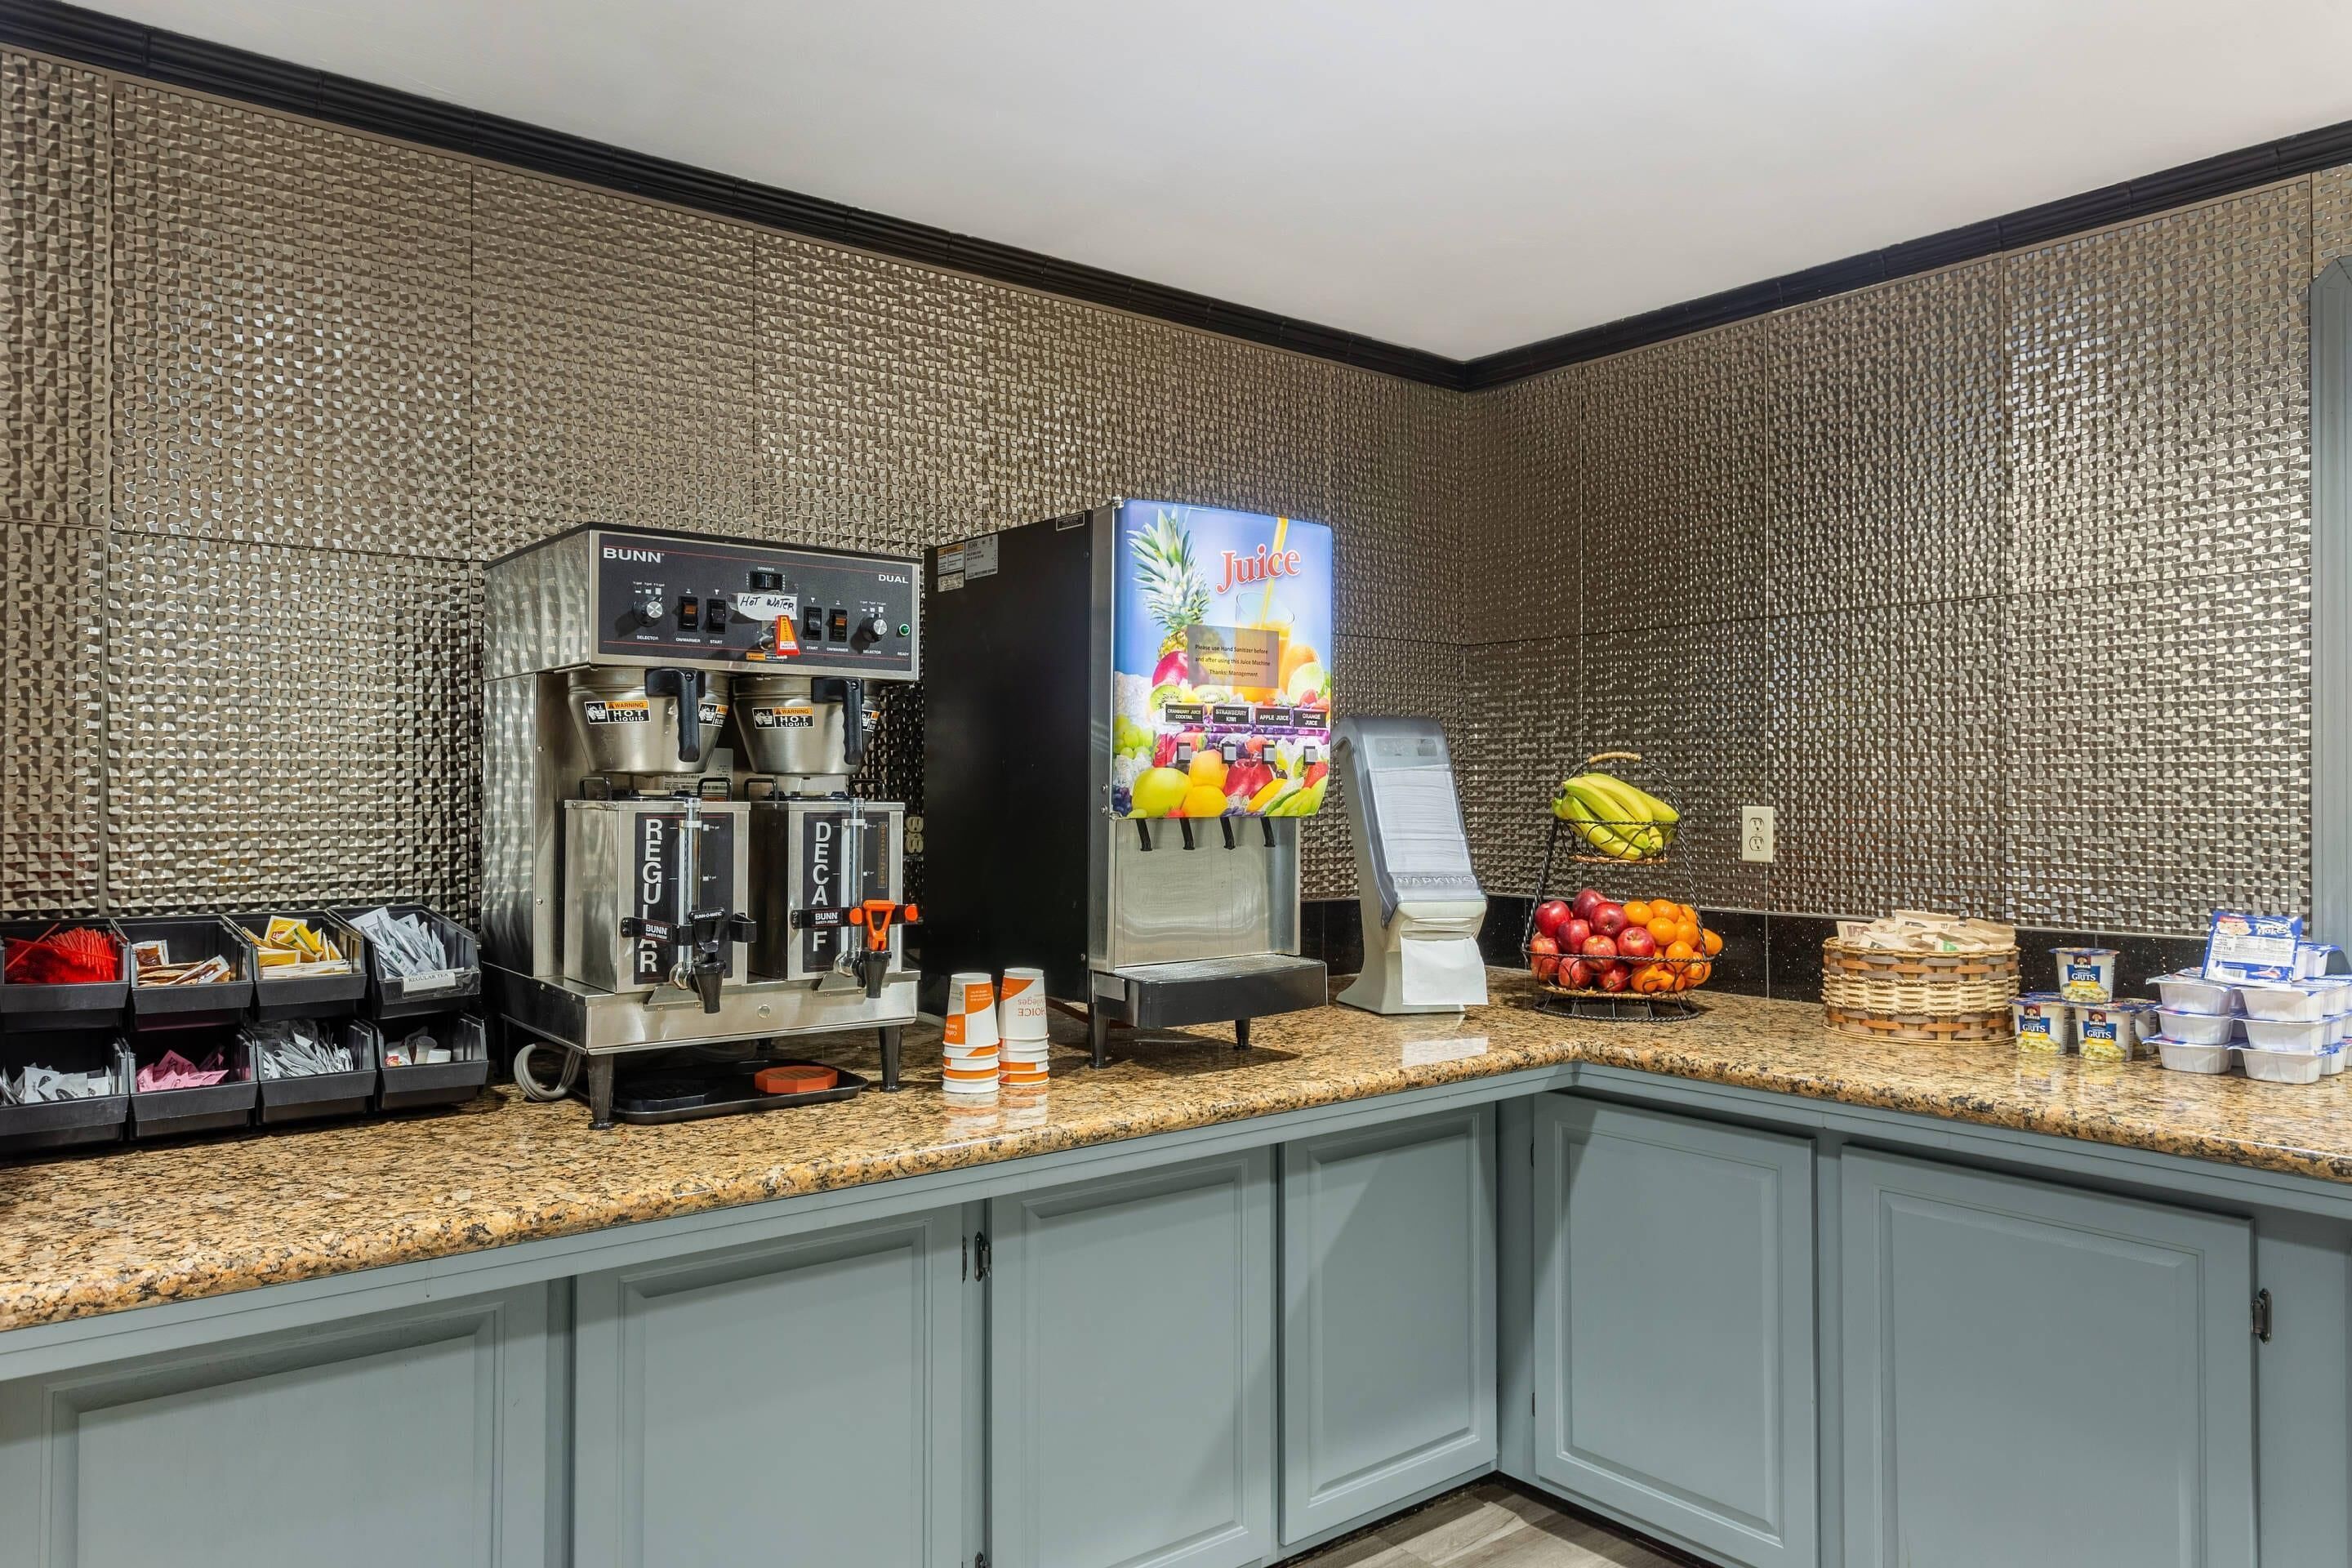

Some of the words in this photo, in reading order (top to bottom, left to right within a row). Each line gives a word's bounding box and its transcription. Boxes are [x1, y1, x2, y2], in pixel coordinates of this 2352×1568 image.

[604, 547, 662, 564] BUNN
[1216, 544, 1301, 594] Juice
[878, 574, 909, 584] DUAL
[613, 710, 644, 718] HOT
[1396, 875, 1473, 884] NAPKINS
[812, 822, 831, 951] DECAF
[815, 912, 839, 920] BUNN
[645, 924, 668, 935] BUNN
[2071, 973, 2096, 981] GRITS
[1018, 1007, 1046, 1017] HOICE
[2022, 1024, 2046, 1033] GRITS
[2087, 1029, 2112, 1039] GRITS
